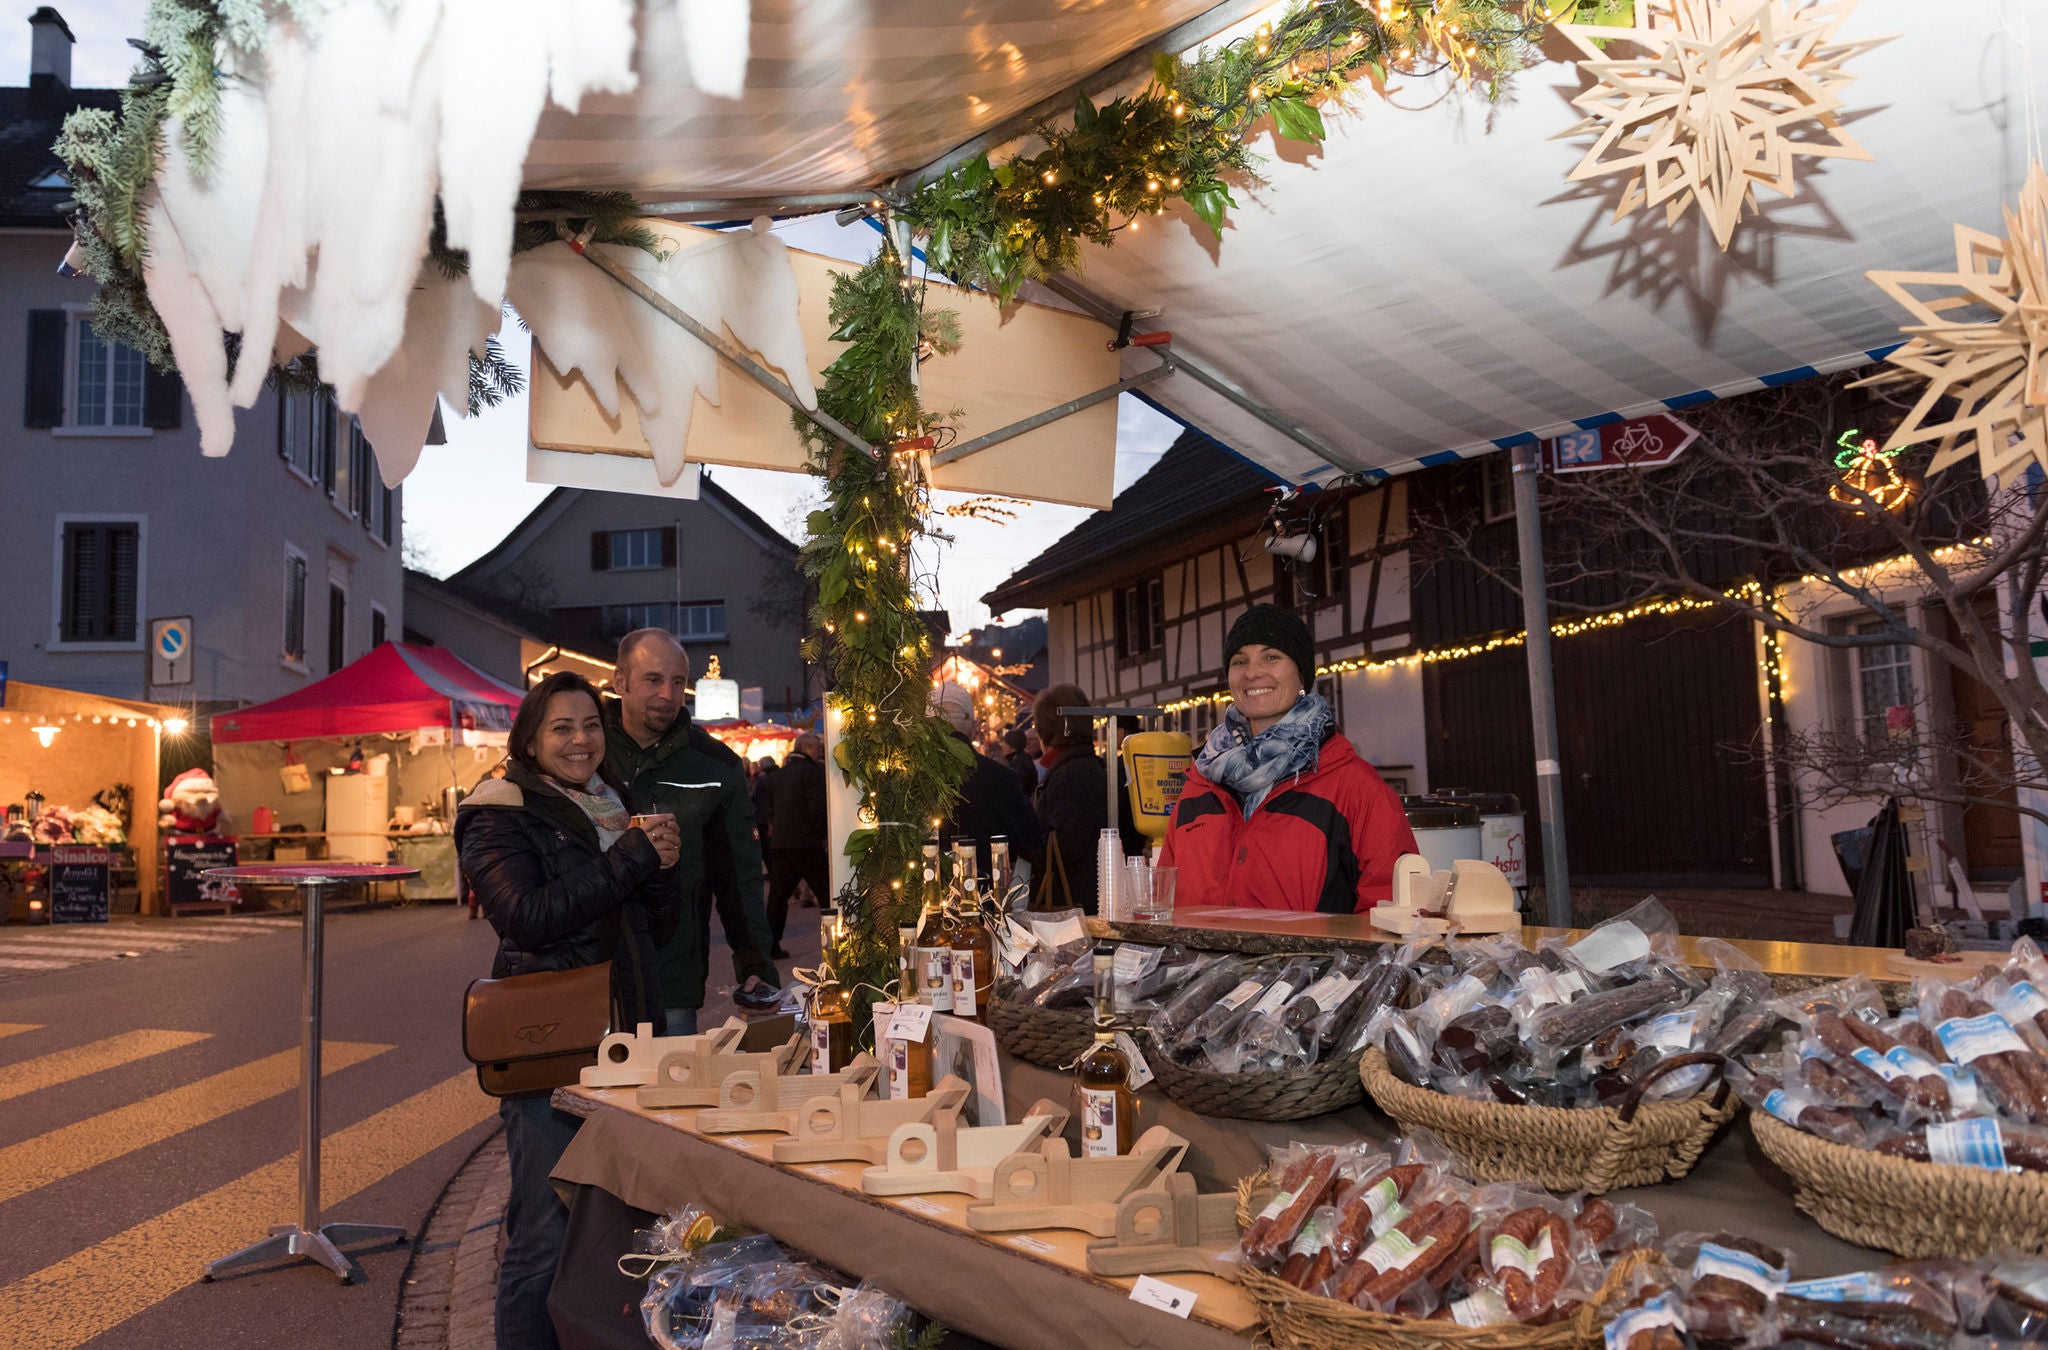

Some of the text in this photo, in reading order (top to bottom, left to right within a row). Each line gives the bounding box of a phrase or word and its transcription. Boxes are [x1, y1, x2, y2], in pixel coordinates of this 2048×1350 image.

[1561, 433, 1595, 461] 32
[53, 849, 108, 863] Sinalco
[1491, 856, 1521, 872] hstar
